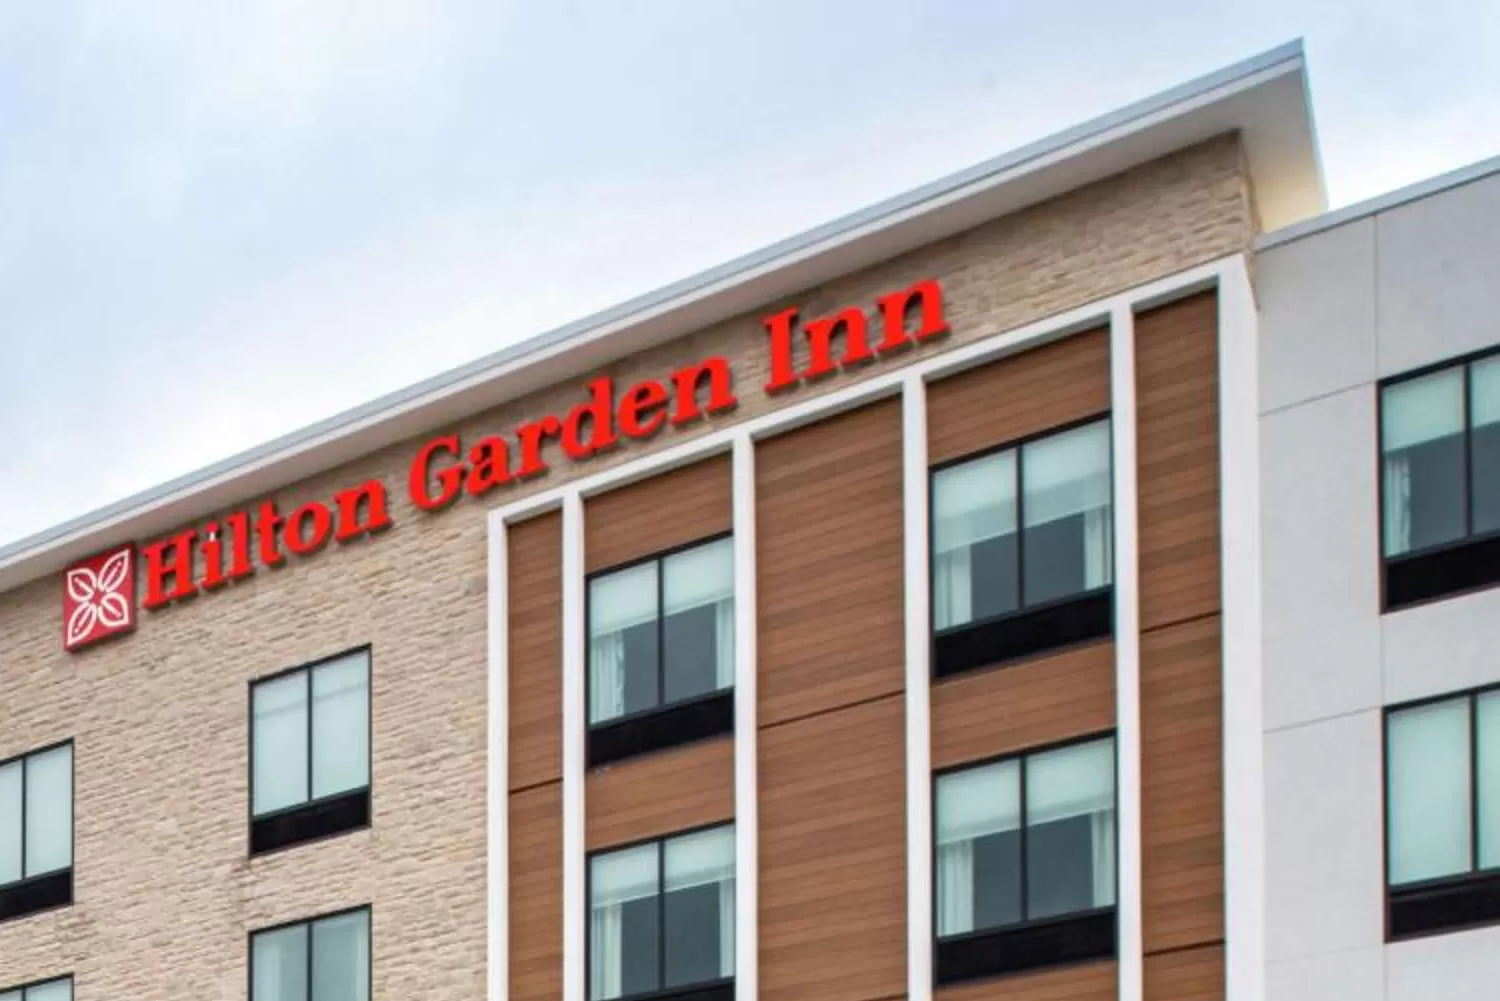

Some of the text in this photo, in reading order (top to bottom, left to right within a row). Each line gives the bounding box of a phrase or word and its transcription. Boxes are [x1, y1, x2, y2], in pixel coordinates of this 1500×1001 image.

[141, 277, 951, 610] Hilton Garden Inn
